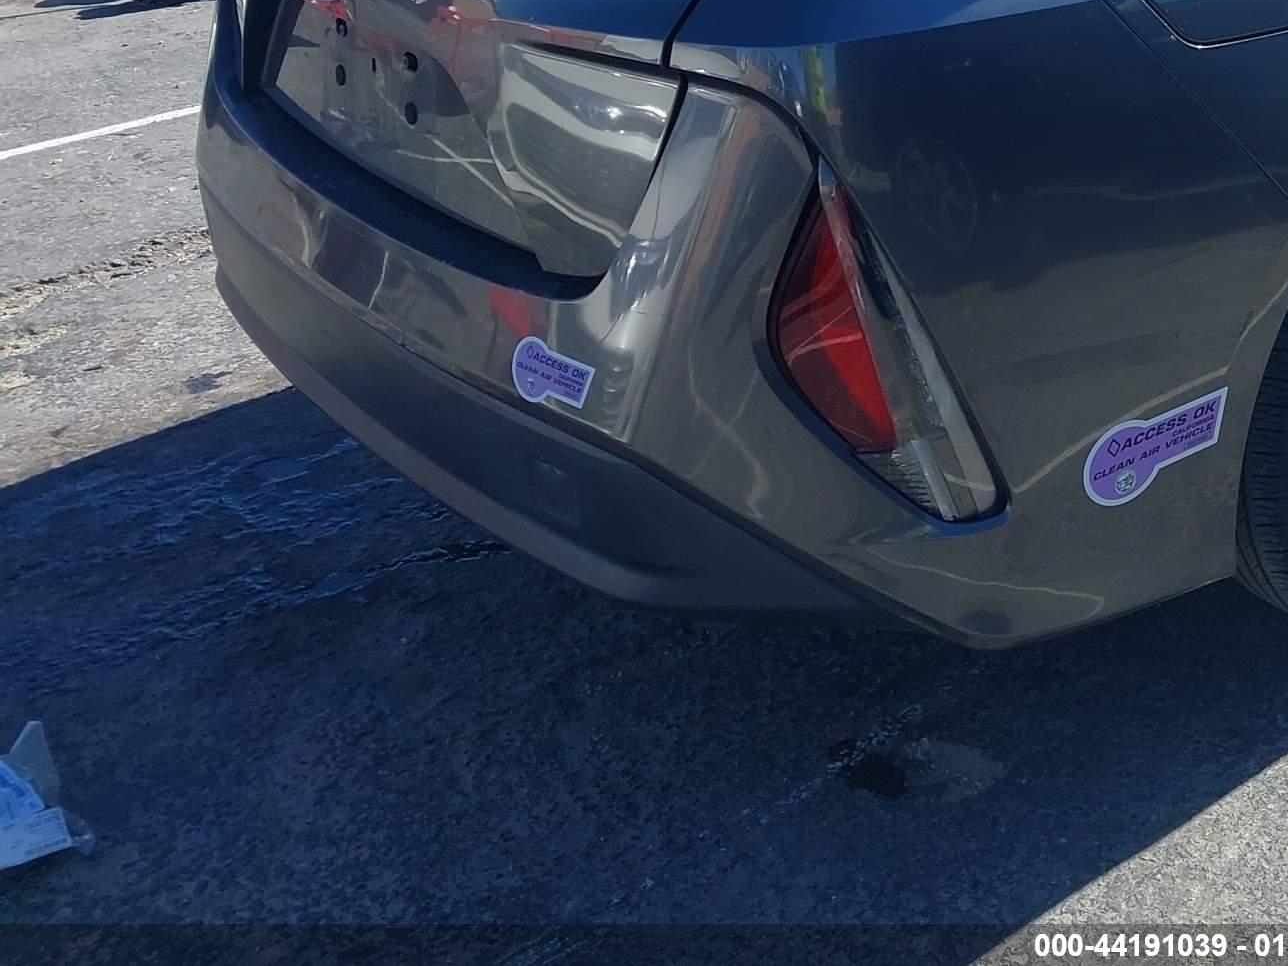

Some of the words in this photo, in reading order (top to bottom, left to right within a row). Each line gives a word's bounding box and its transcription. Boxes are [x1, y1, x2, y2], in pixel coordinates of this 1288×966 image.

[533, 352, 569, 374] ACCESS
[571, 369, 586, 381] OK
[1093, 456, 1136, 482] CLEAN
[1138, 445, 1161, 462] AIR
[1165, 422, 1214, 450] VEHICLE
[1121, 414, 1188, 452] ACCESS
[1193, 400, 1217, 420] OK
